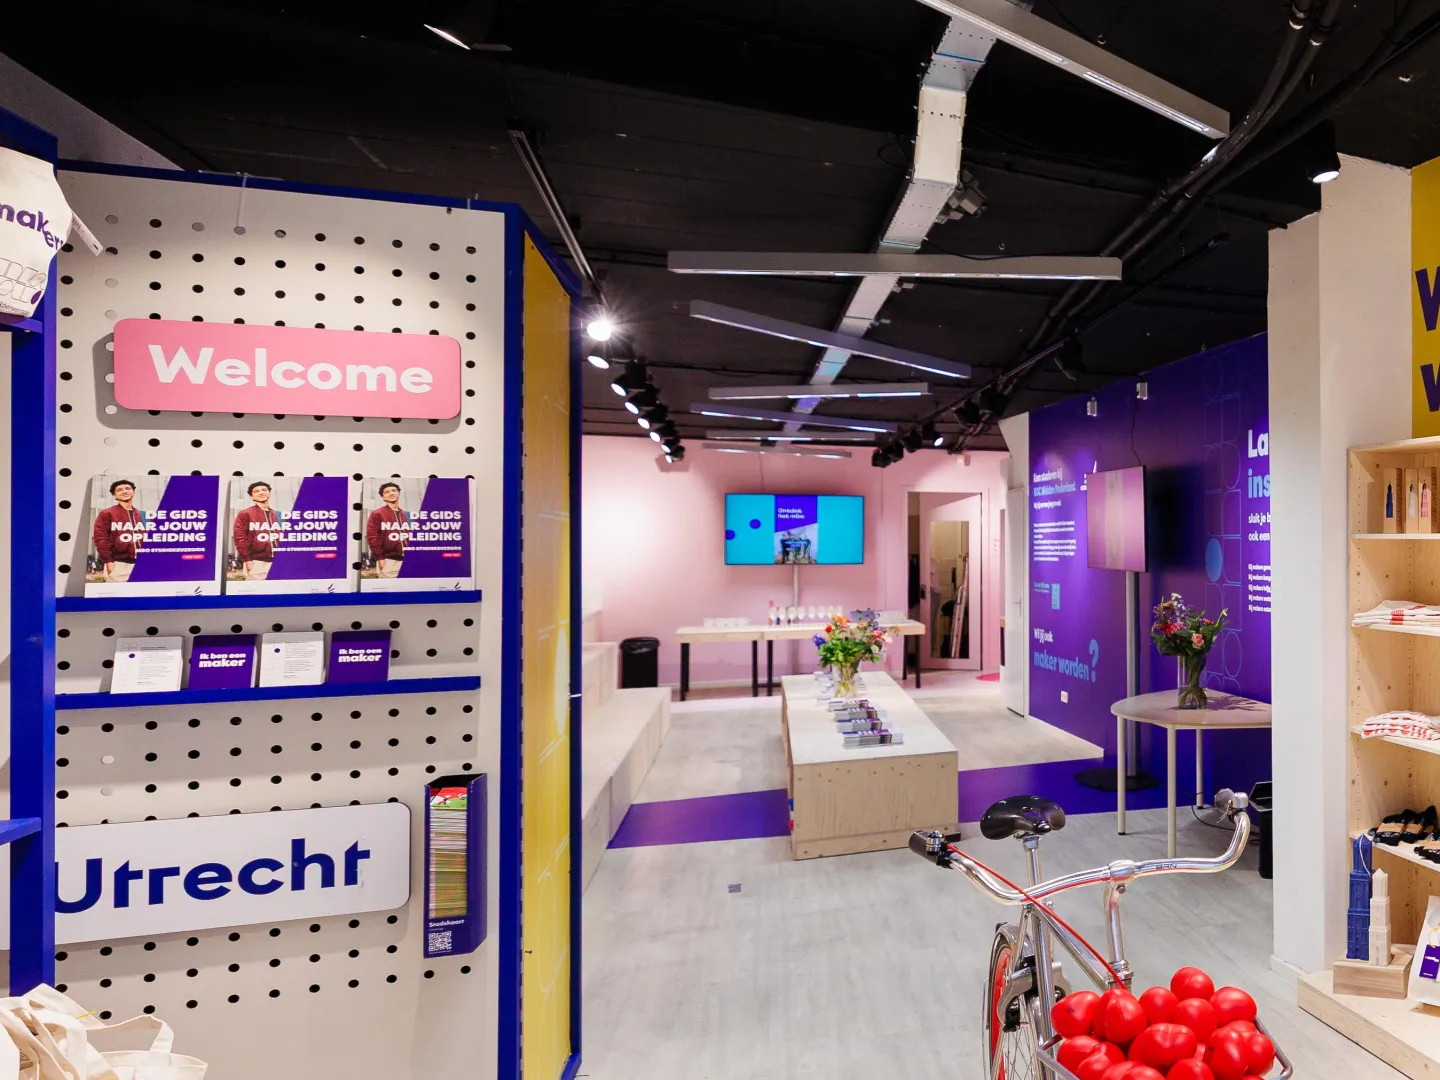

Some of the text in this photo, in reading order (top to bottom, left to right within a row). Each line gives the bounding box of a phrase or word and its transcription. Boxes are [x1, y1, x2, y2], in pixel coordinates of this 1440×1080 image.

[0, 202, 64, 251] maker
[148, 344, 433, 394] Welcome
[145, 510, 208, 520] DE GIDS
[281, 510, 338, 520] DE GIDS
[410, 510, 462, 520] DE GIDS
[110, 522, 208, 531] NAAR JOUW
[249, 521, 338, 531] NAAR JOUW
[380, 522, 462, 531] NAAR JOUW
[119, 532, 206, 542] OPLEIDING
[257, 532, 338, 542] OPLEIDING
[388, 532, 462, 542] OPLEIDING
[338, 652, 382, 662] maker
[1034, 650, 1056, 672] maker
[198, 658, 246, 668] maker
[54, 837, 371, 914] Utrecht
